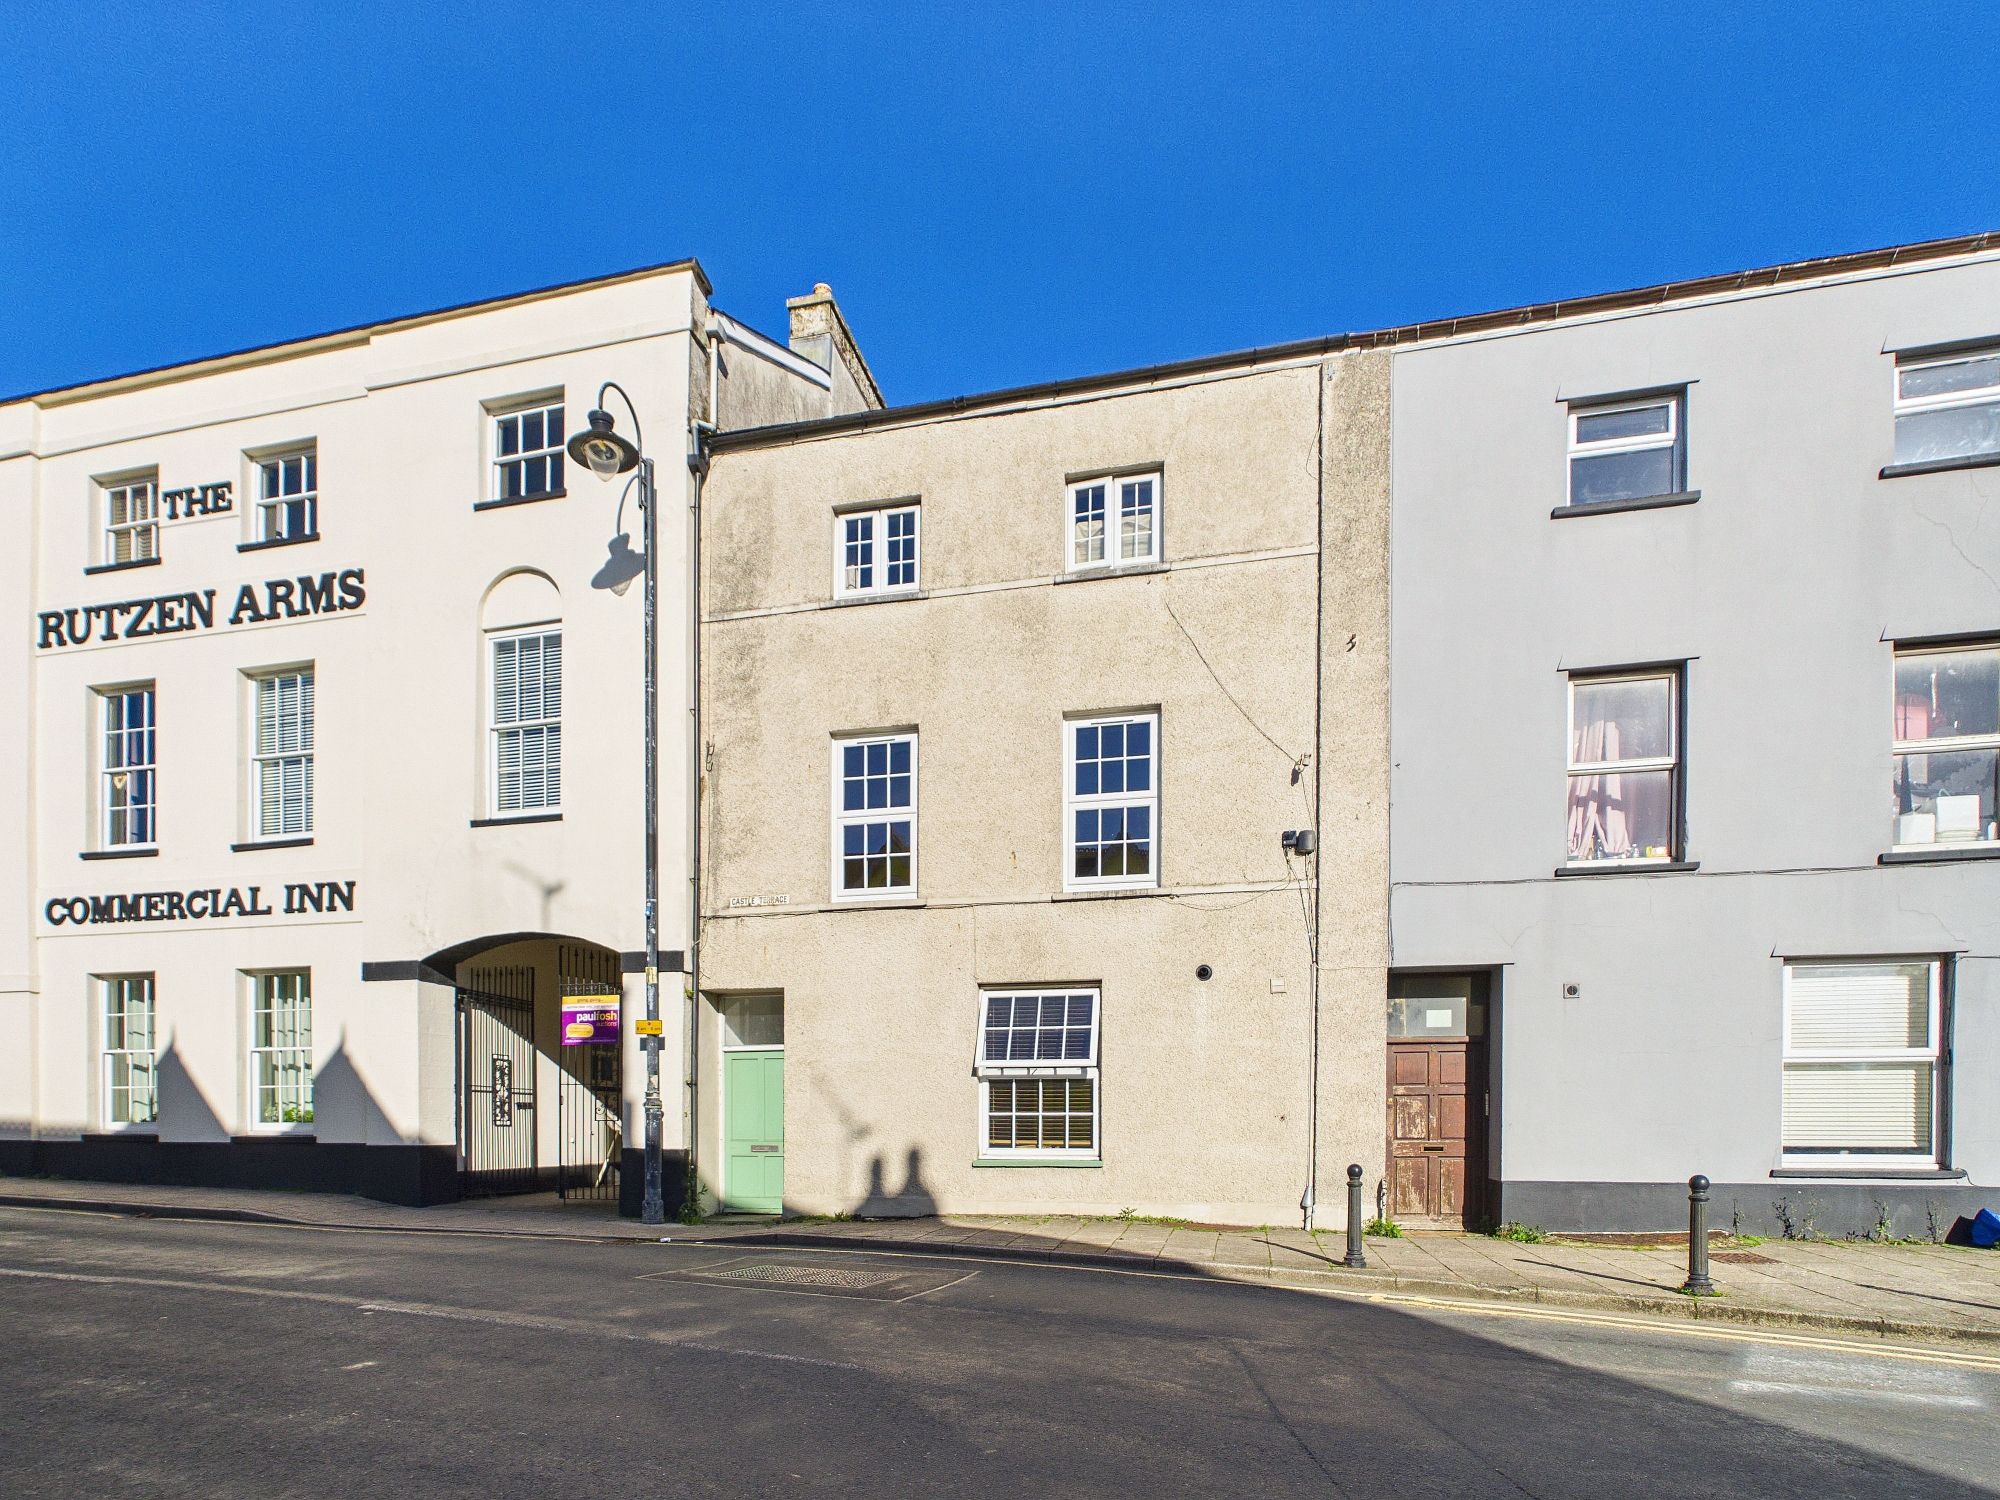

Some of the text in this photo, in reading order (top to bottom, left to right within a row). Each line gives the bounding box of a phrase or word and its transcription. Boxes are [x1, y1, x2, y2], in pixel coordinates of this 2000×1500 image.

[162, 480, 233, 520] THE
[37, 568, 366, 649] RUTZEN ARMS
[45, 880, 356, 926] COMMERCIAL INN
[731, 898, 755, 906] CASTLE
